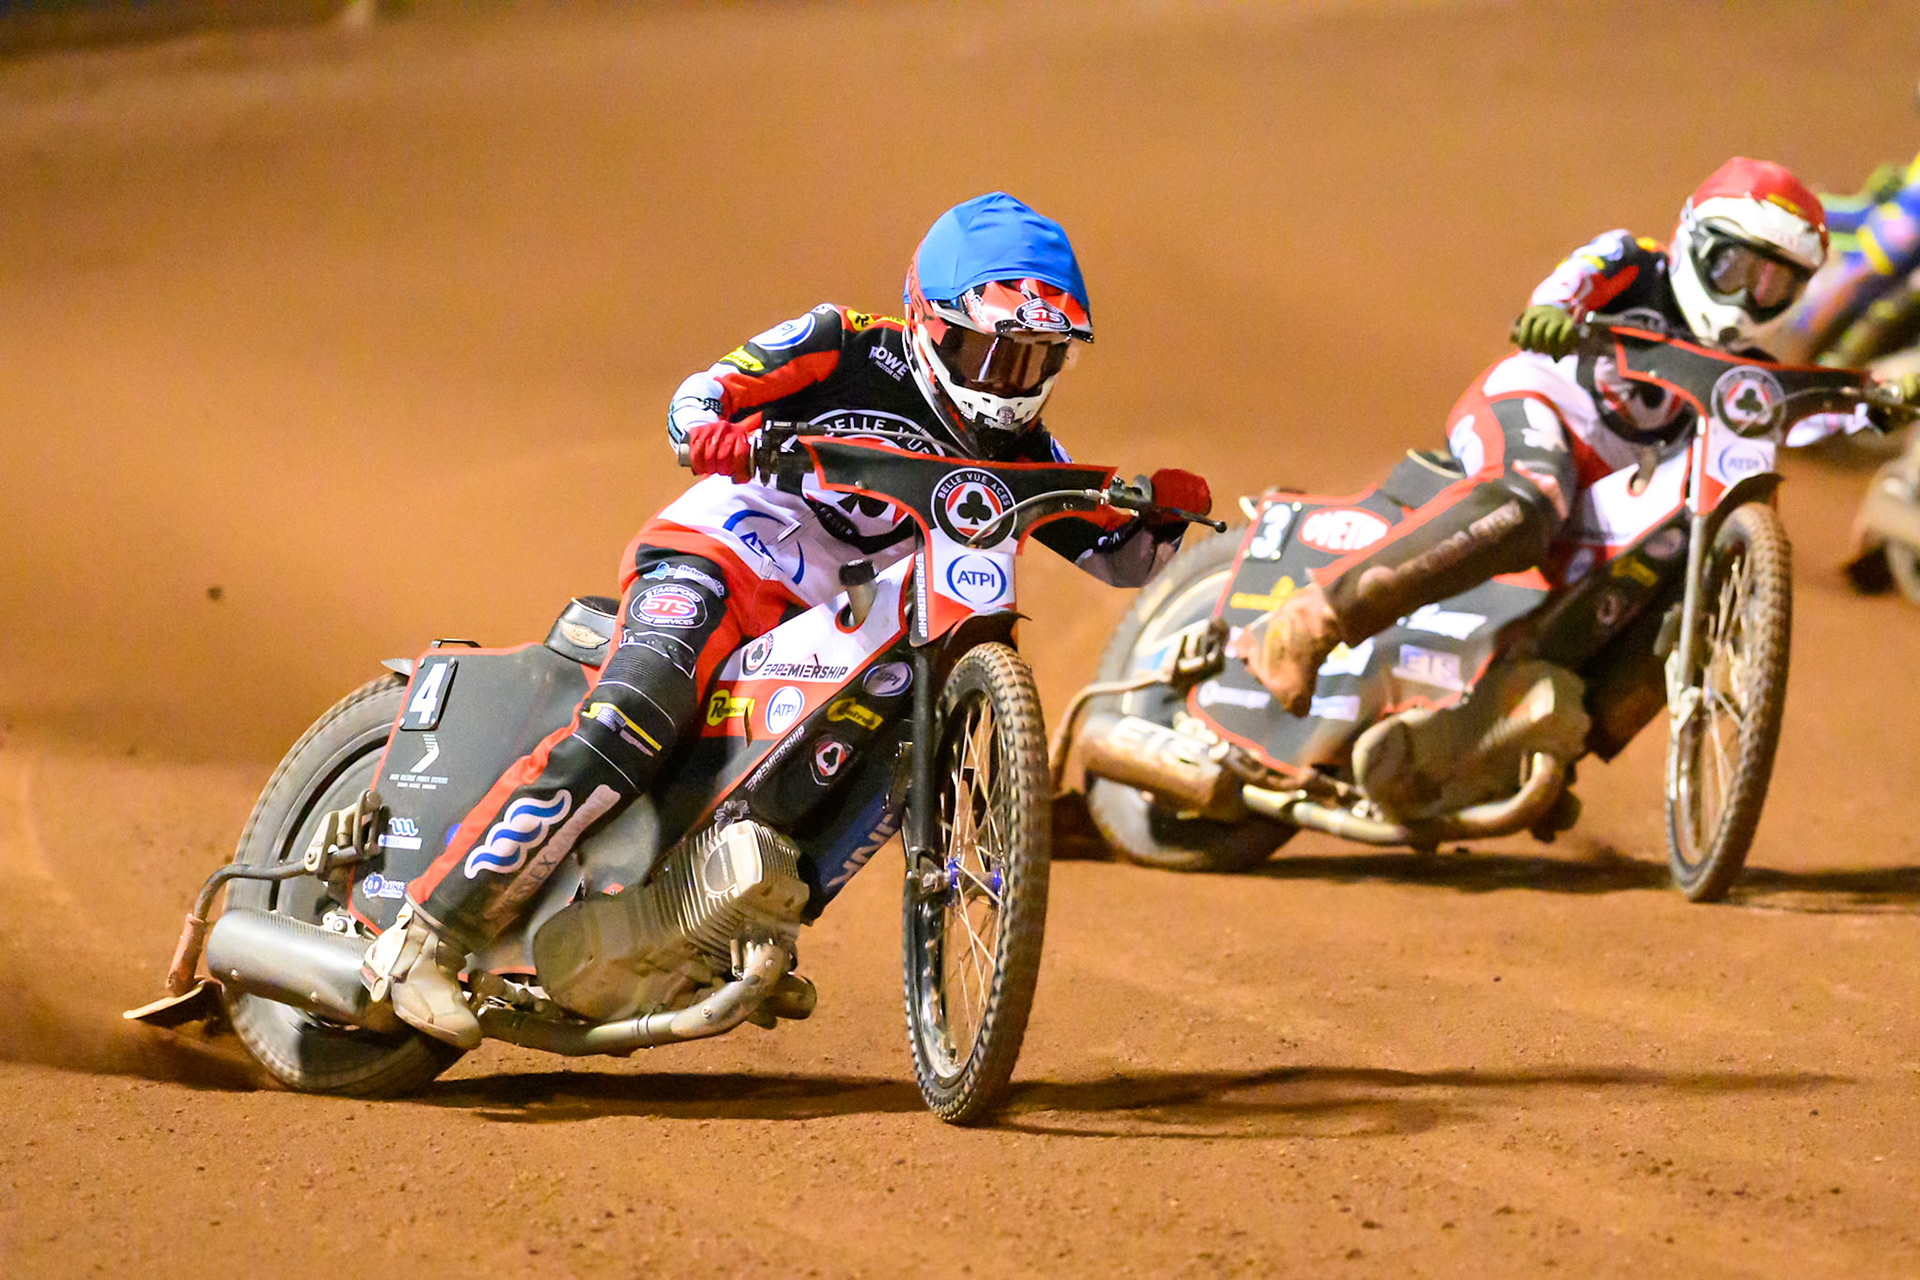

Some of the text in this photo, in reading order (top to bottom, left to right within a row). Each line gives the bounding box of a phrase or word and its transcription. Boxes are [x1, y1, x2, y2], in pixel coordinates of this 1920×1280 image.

[1026, 308, 1061, 323] STS
[869, 346, 910, 377] ROWE
[875, 360, 893, 375] MOTOR
[937, 473, 1011, 506] BELLE VUE ACES
[1250, 504, 1292, 559] 3
[957, 571, 995, 588] ATPI
[642, 599, 694, 615] STS
[409, 663, 448, 724] 4
[773, 704, 796, 716] ATPI
